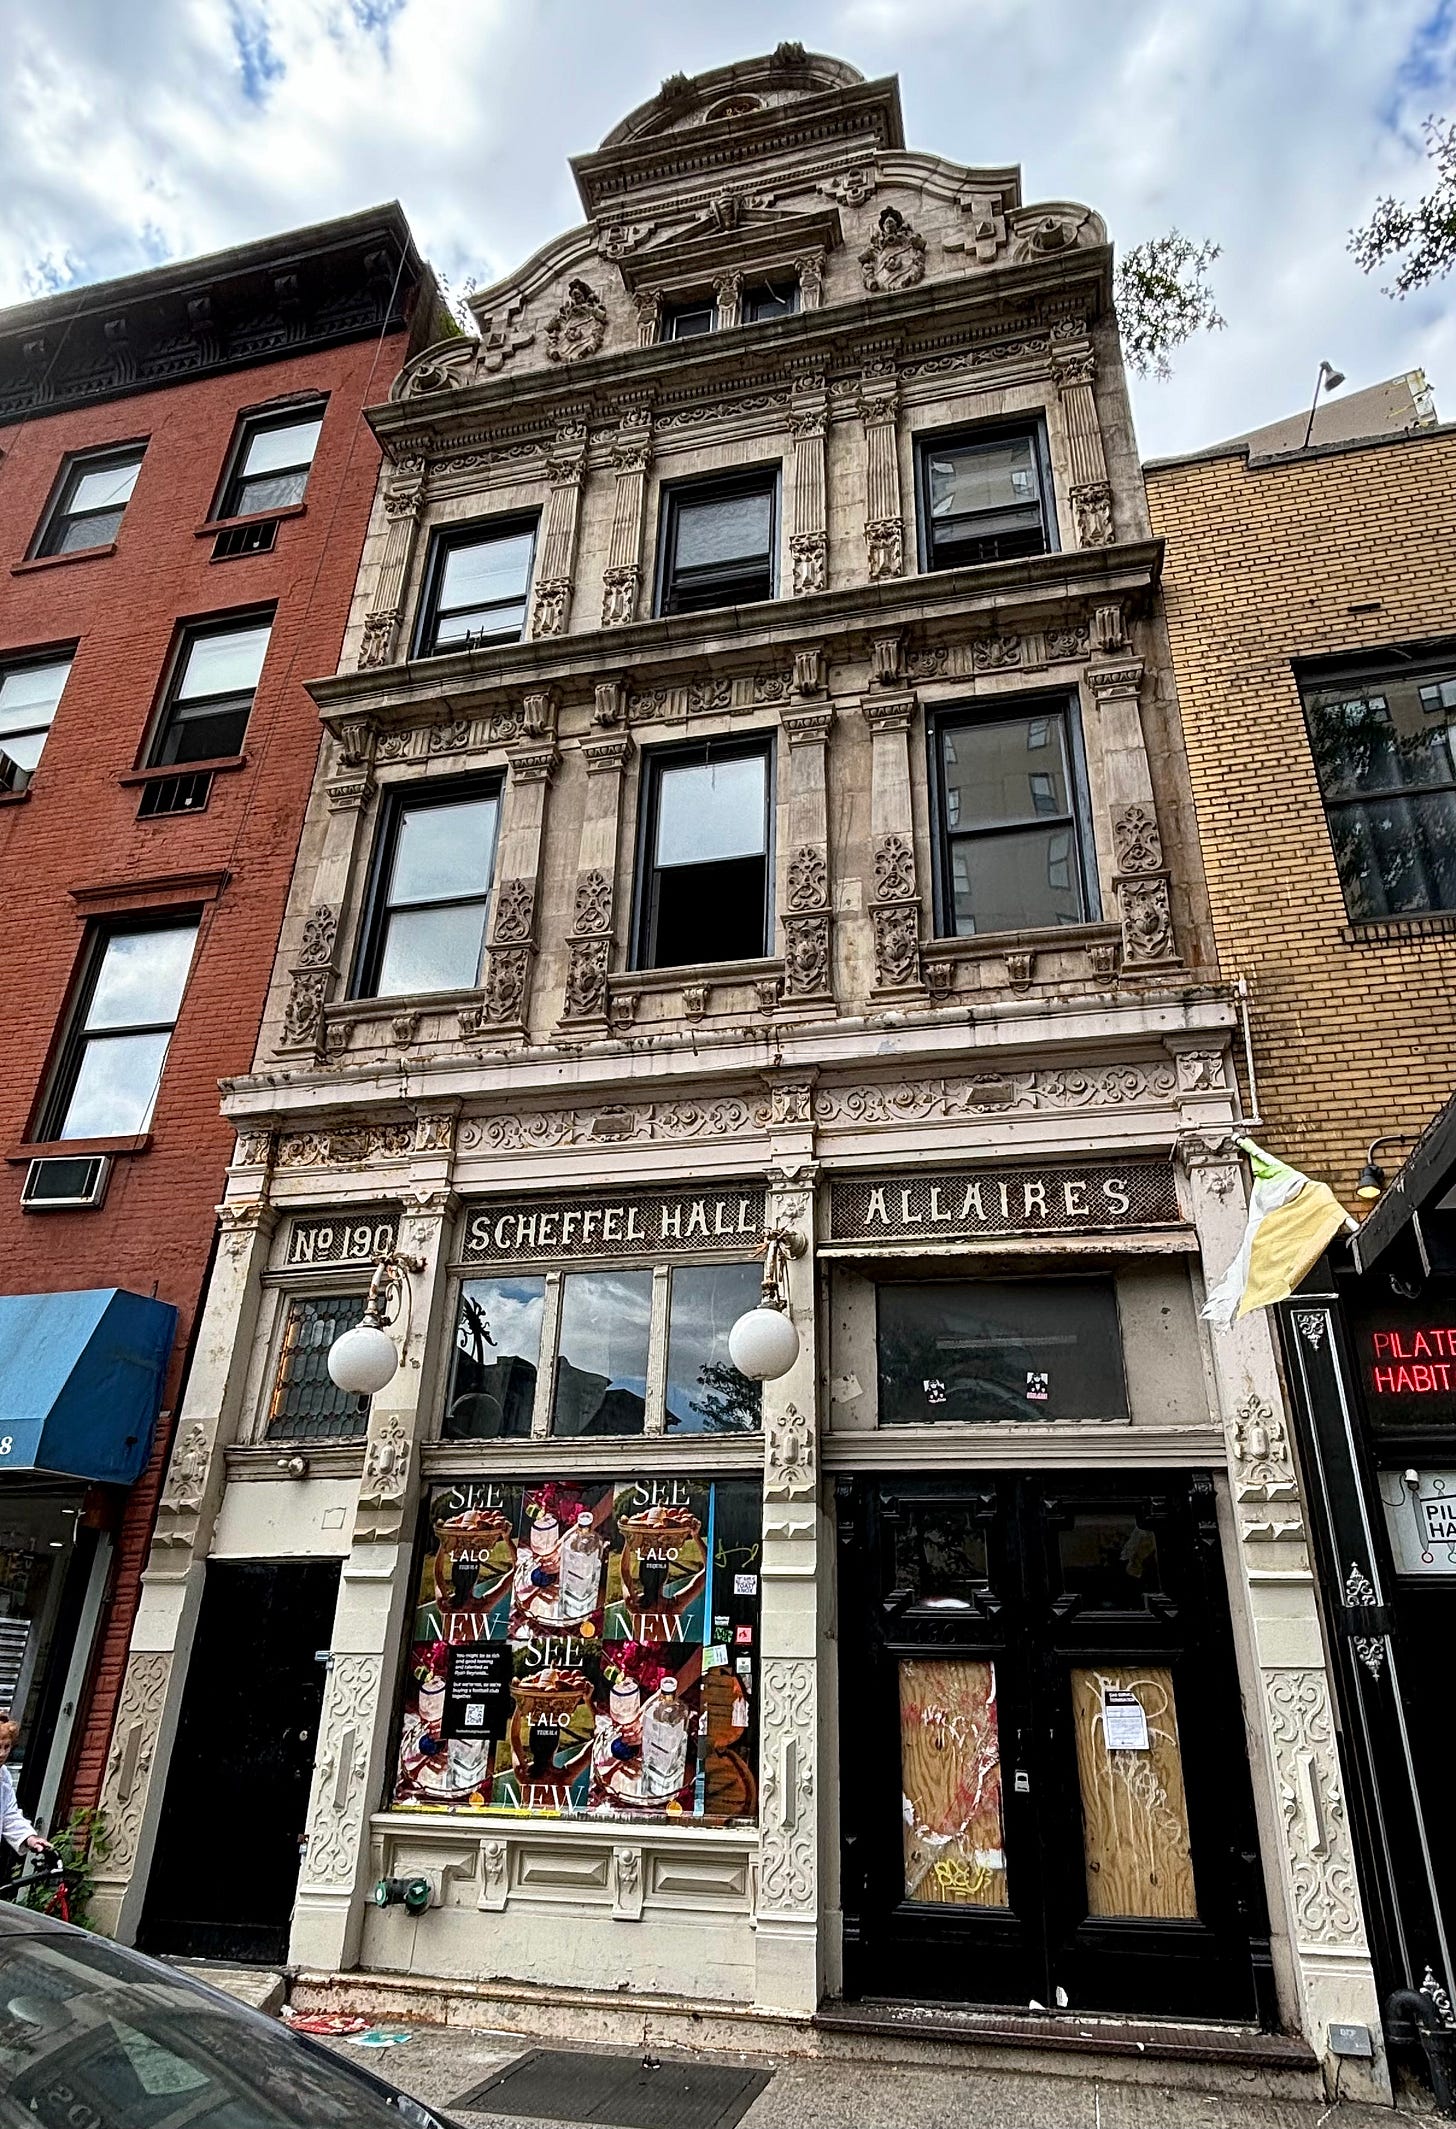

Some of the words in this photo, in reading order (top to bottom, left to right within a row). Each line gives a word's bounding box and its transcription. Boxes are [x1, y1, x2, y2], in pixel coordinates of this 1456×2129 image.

[863, 1179, 1130, 1225] ALLAIRES
[468, 1206, 645, 1250] SCHEFFEL
[661, 1200, 757, 1239] HALL
[340, 1224, 394, 1258] 190
[1375, 1364, 1450, 1393] HABIT
[0, 1435, 13, 1455] 8
[449, 1484, 504, 1509] SEE
[632, 1480, 690, 1506] SEE
[1426, 1505, 1456, 1520] PIL
[450, 1549, 490, 1562] LALO
[635, 1547, 679, 1561] LALO
[426, 1612, 502, 1641] NEW
[615, 1613, 696, 1643] NEW
[524, 1635, 585, 1667] SEE
[527, 1713, 571, 1727] LALO
[502, 1783, 585, 1813] NEW
